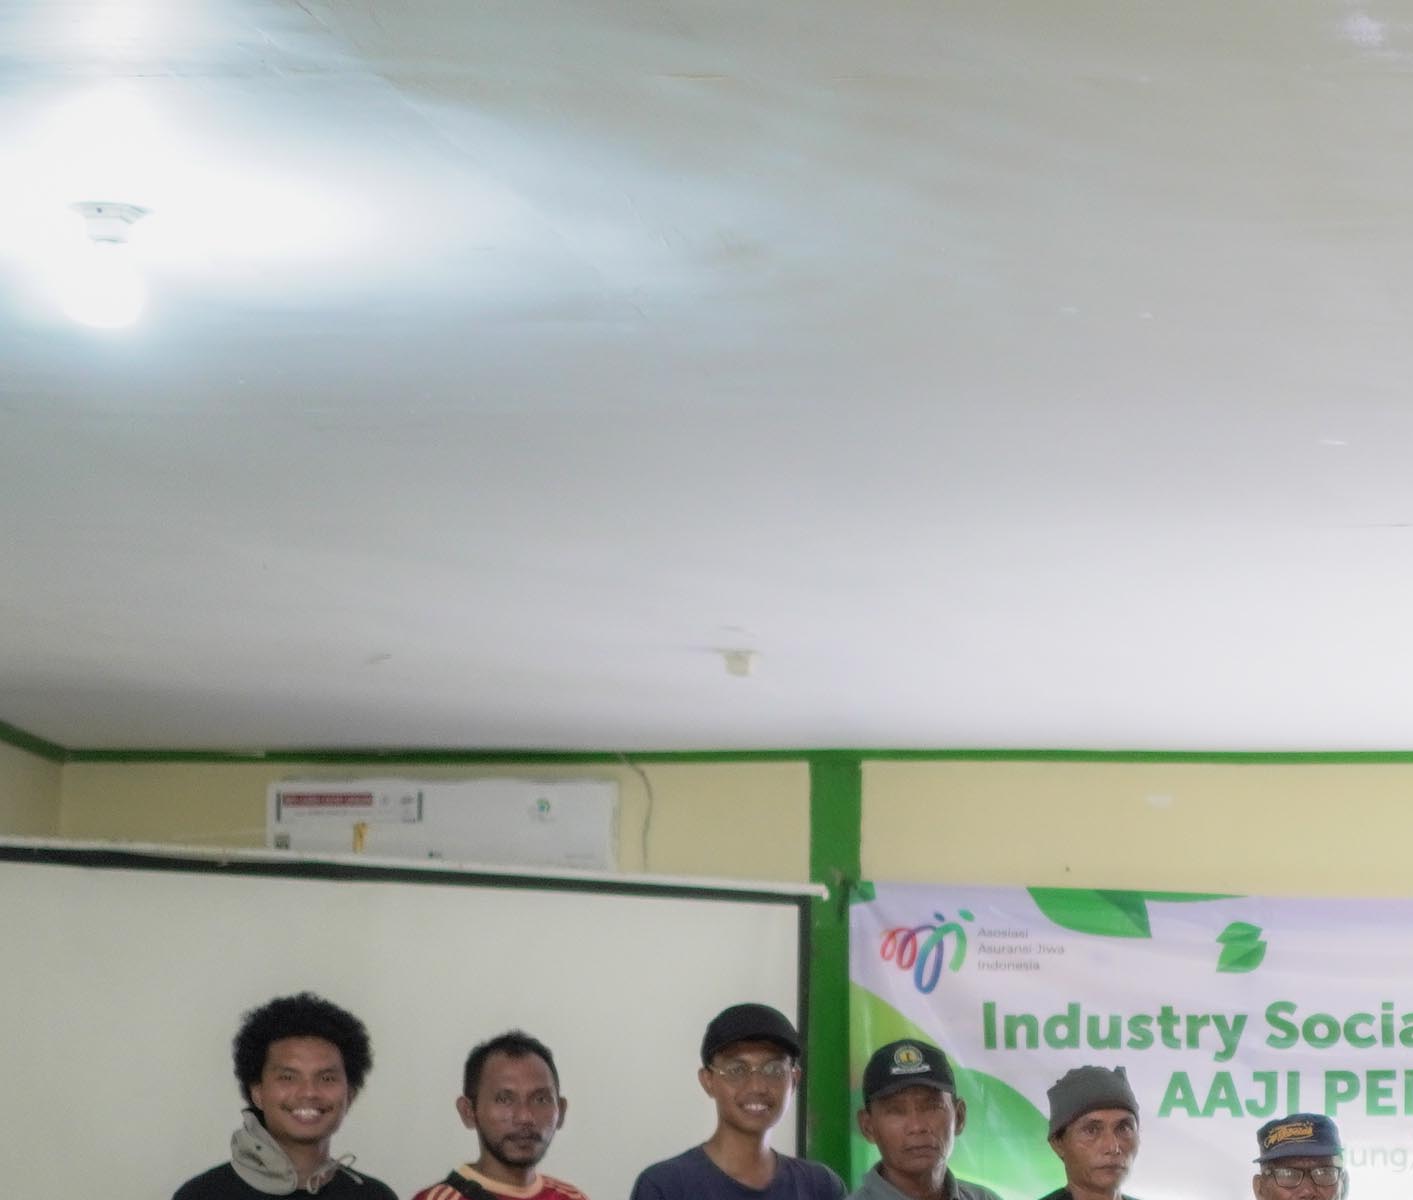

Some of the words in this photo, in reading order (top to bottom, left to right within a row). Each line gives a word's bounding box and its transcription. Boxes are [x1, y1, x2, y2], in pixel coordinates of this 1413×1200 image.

[977, 927, 1029, 939] Asosiasi
[977, 944, 1035, 955] Asuransi
[1038, 944, 1065, 955] Jiwa
[977, 960, 1040, 971] Indonesia
[983, 1001, 1248, 1062] Industry
[1157, 1071, 1299, 1119] AAJI
